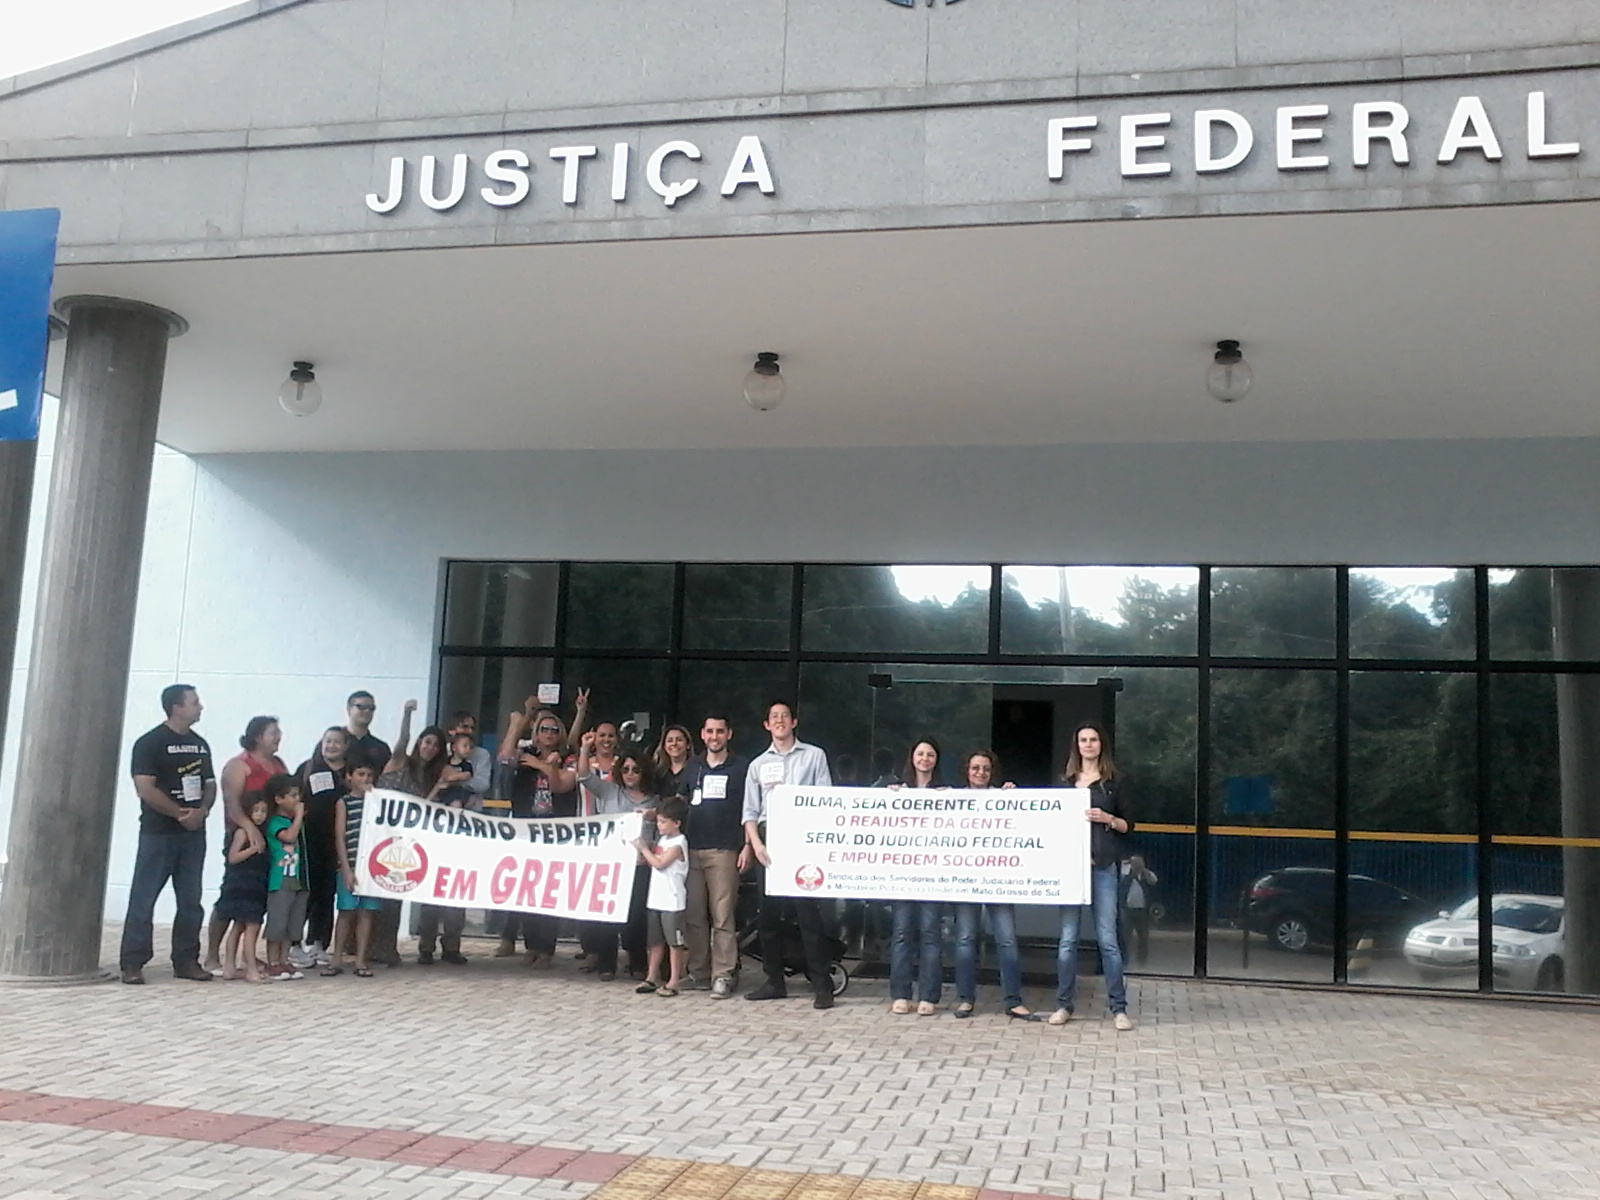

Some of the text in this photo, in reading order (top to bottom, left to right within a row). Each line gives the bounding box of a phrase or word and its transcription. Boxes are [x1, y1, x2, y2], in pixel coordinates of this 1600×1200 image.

[365, 91, 1581, 214] JUSTIÇA FEDERAL
[794, 795, 1062, 812] DILMA, SEJA COERENTE, CONCEDA
[835, 815, 1017, 830] O REAJUSTE DA GENTE.
[805, 832, 1045, 849] SERV. DO JUDICIÁRIO FEDERAL
[828, 851, 1024, 868] E MPU PEDEM SOCORRO.
[432, 866, 478, 901] EM
[490, 855, 622, 915] GREVE!
[952, 876, 978, 884] Poder
[1027, 877, 1061, 886] Federal
[1045, 888, 1061, 897] Sul
